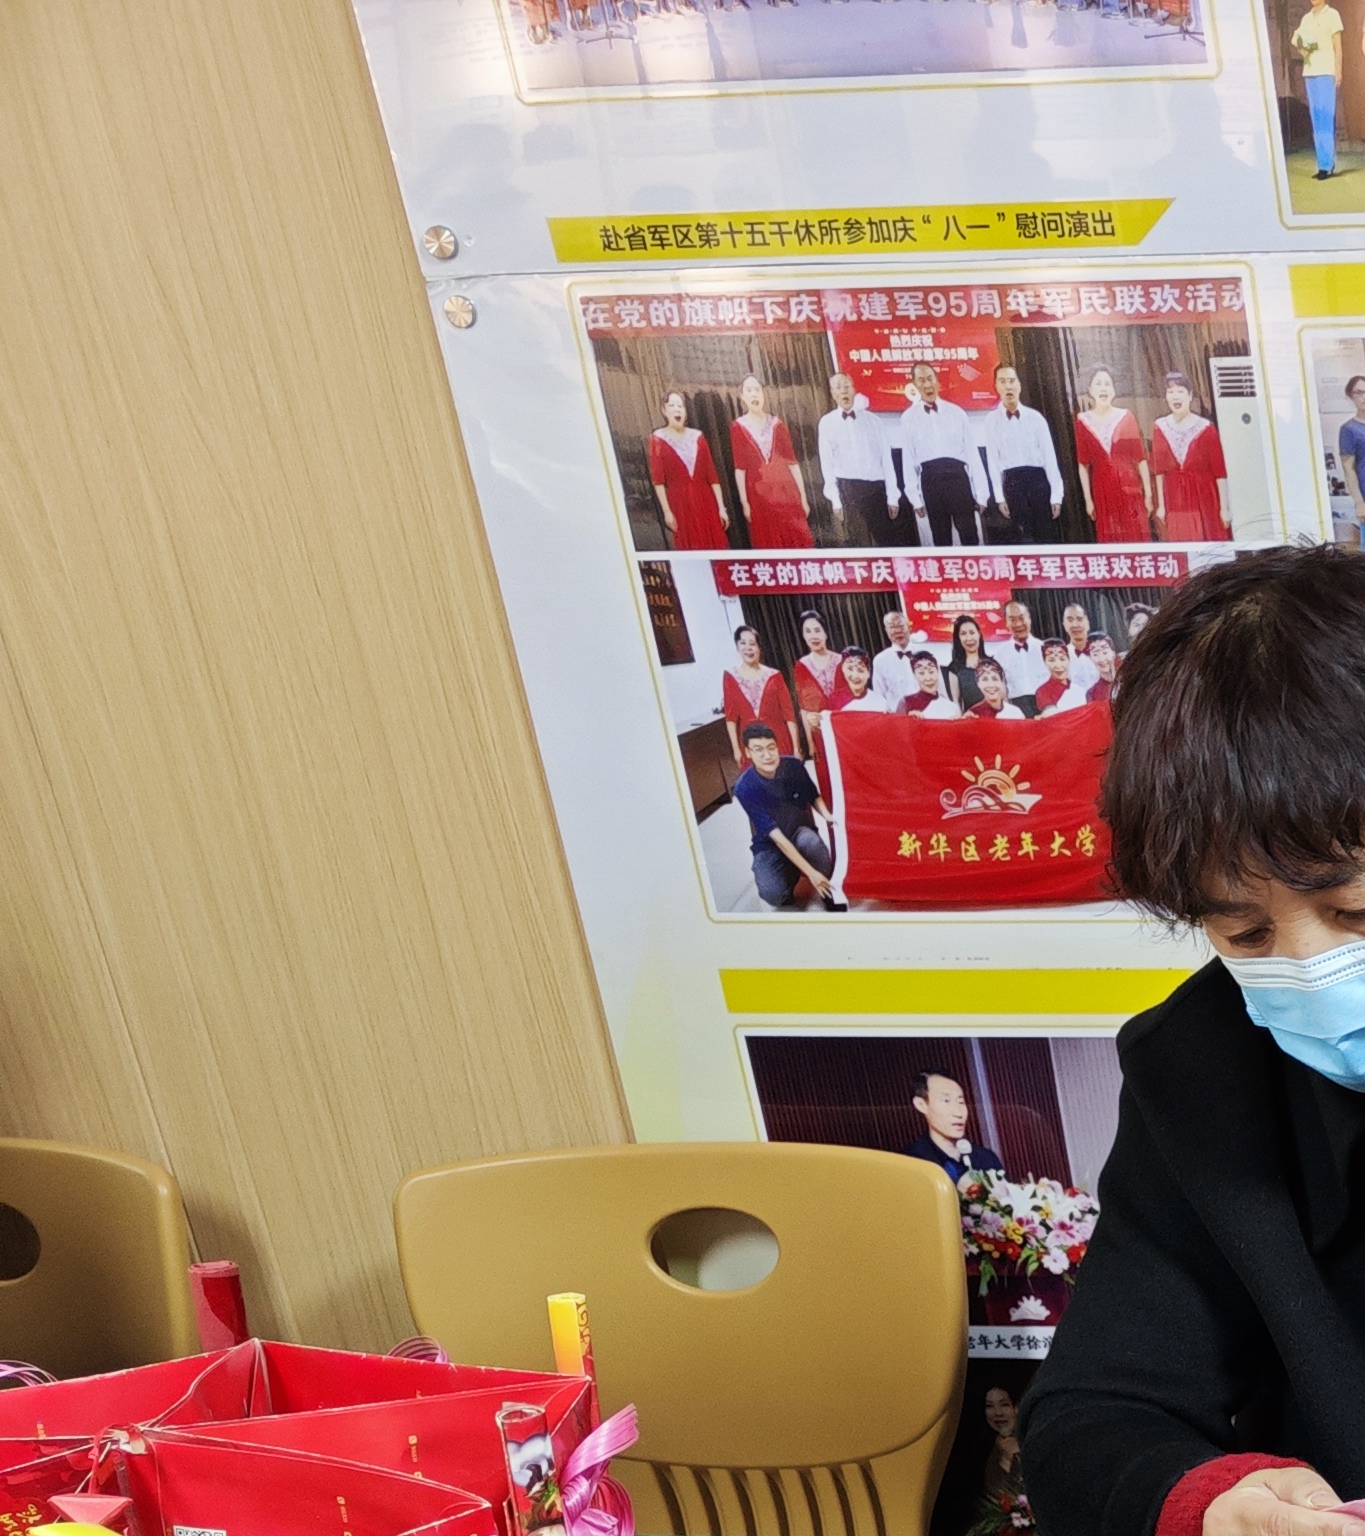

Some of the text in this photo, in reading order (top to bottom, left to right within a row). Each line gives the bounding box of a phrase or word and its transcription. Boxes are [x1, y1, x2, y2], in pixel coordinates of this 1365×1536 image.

[728, 554, 1180, 588] 在党的旗帜下庆祝建军95周年军民联欢活动
[898, 825, 1097, 863] 新华区老年大学
